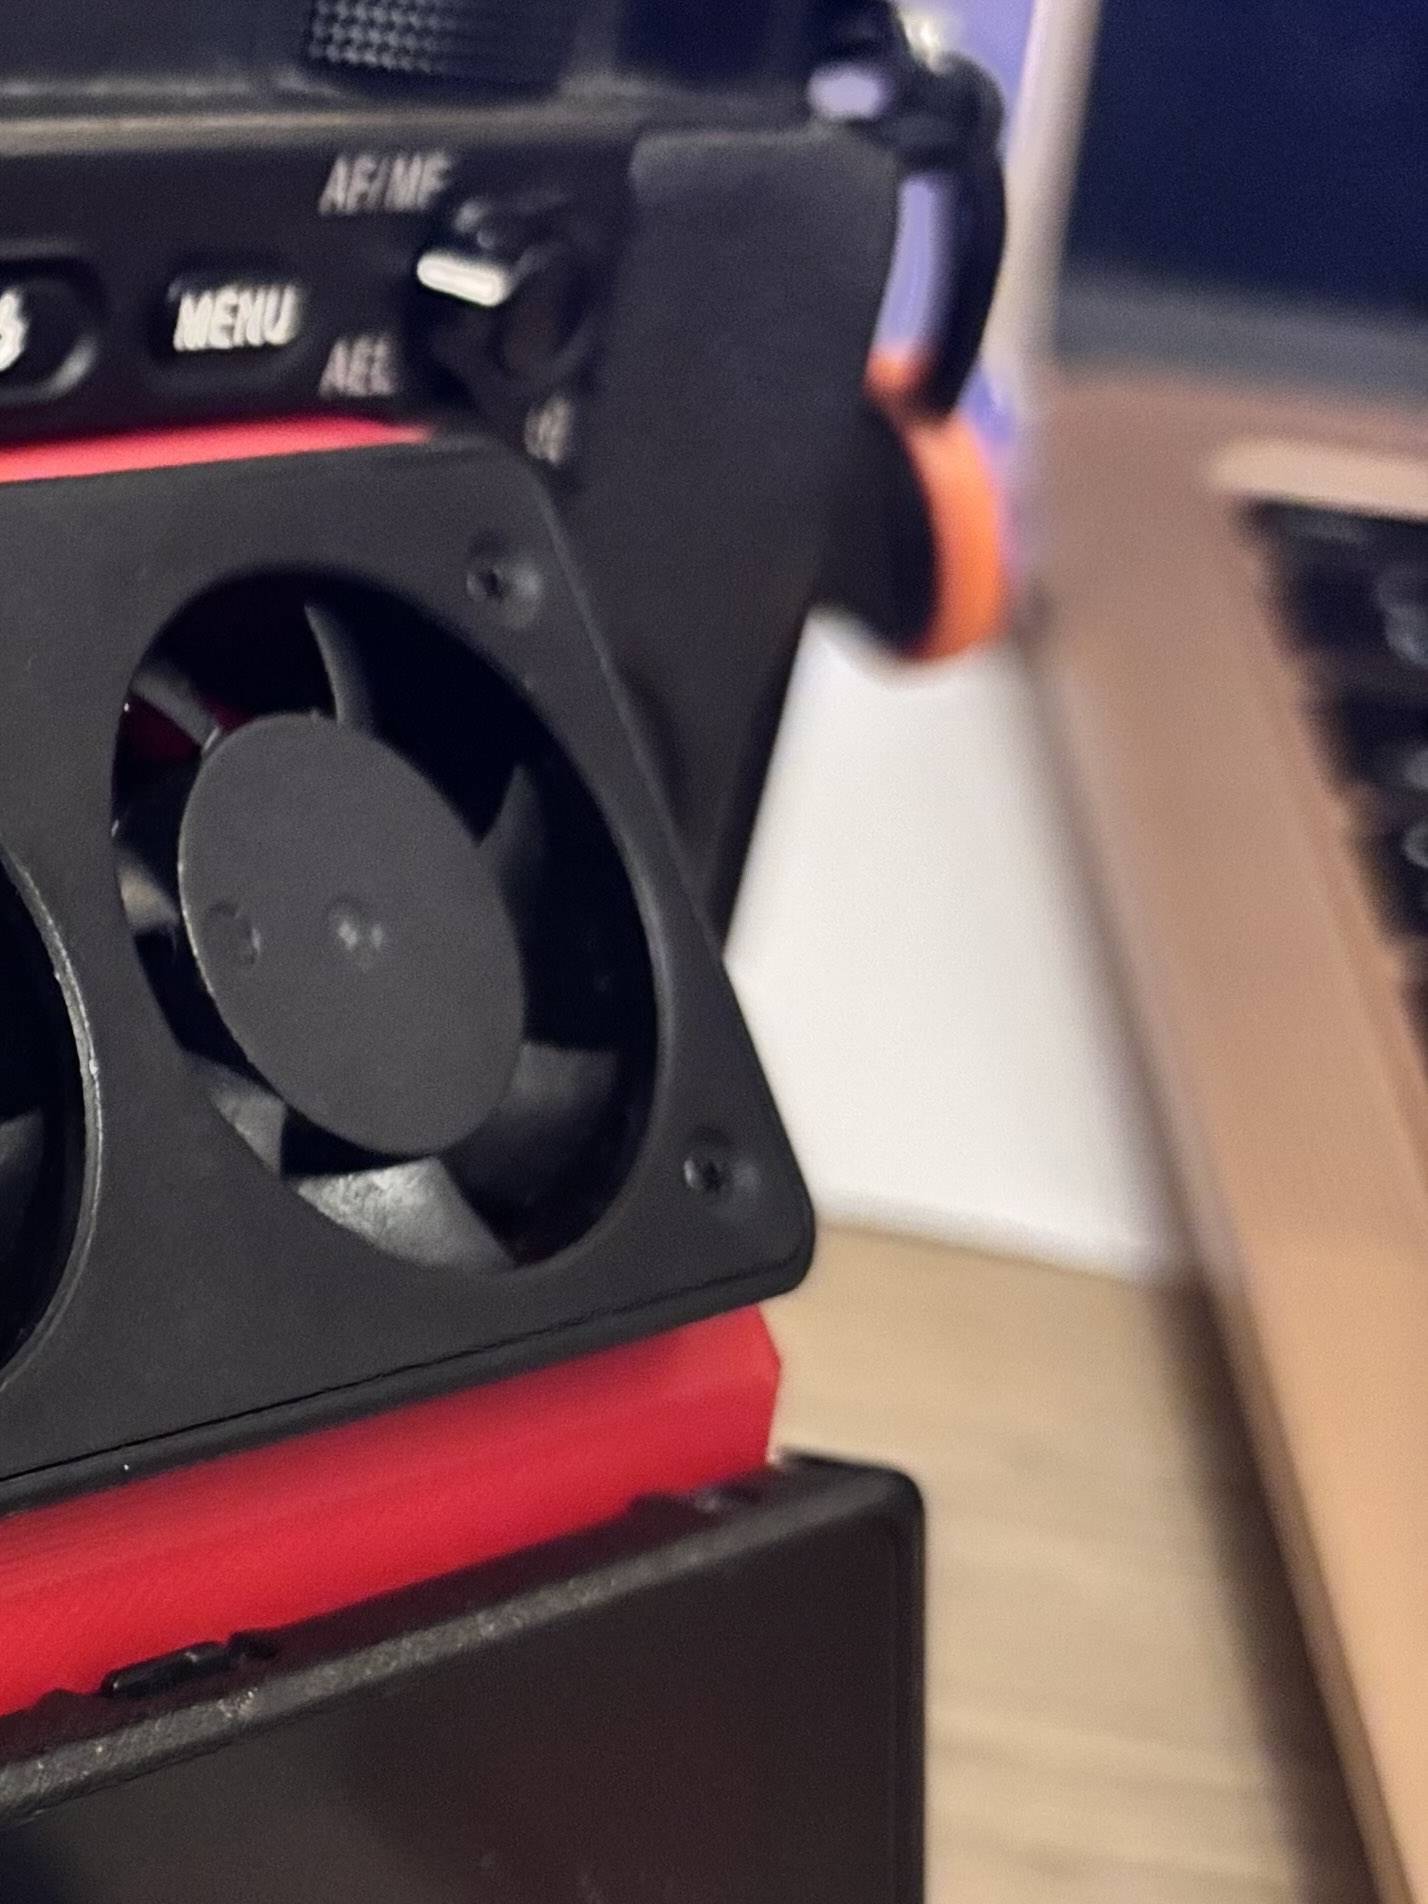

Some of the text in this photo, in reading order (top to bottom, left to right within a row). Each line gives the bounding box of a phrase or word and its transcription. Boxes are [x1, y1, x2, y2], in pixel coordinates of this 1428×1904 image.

[318, 151, 452, 216] AF/MF
[173, 284, 299, 352] MENU
[318, 334, 399, 399] AEL
